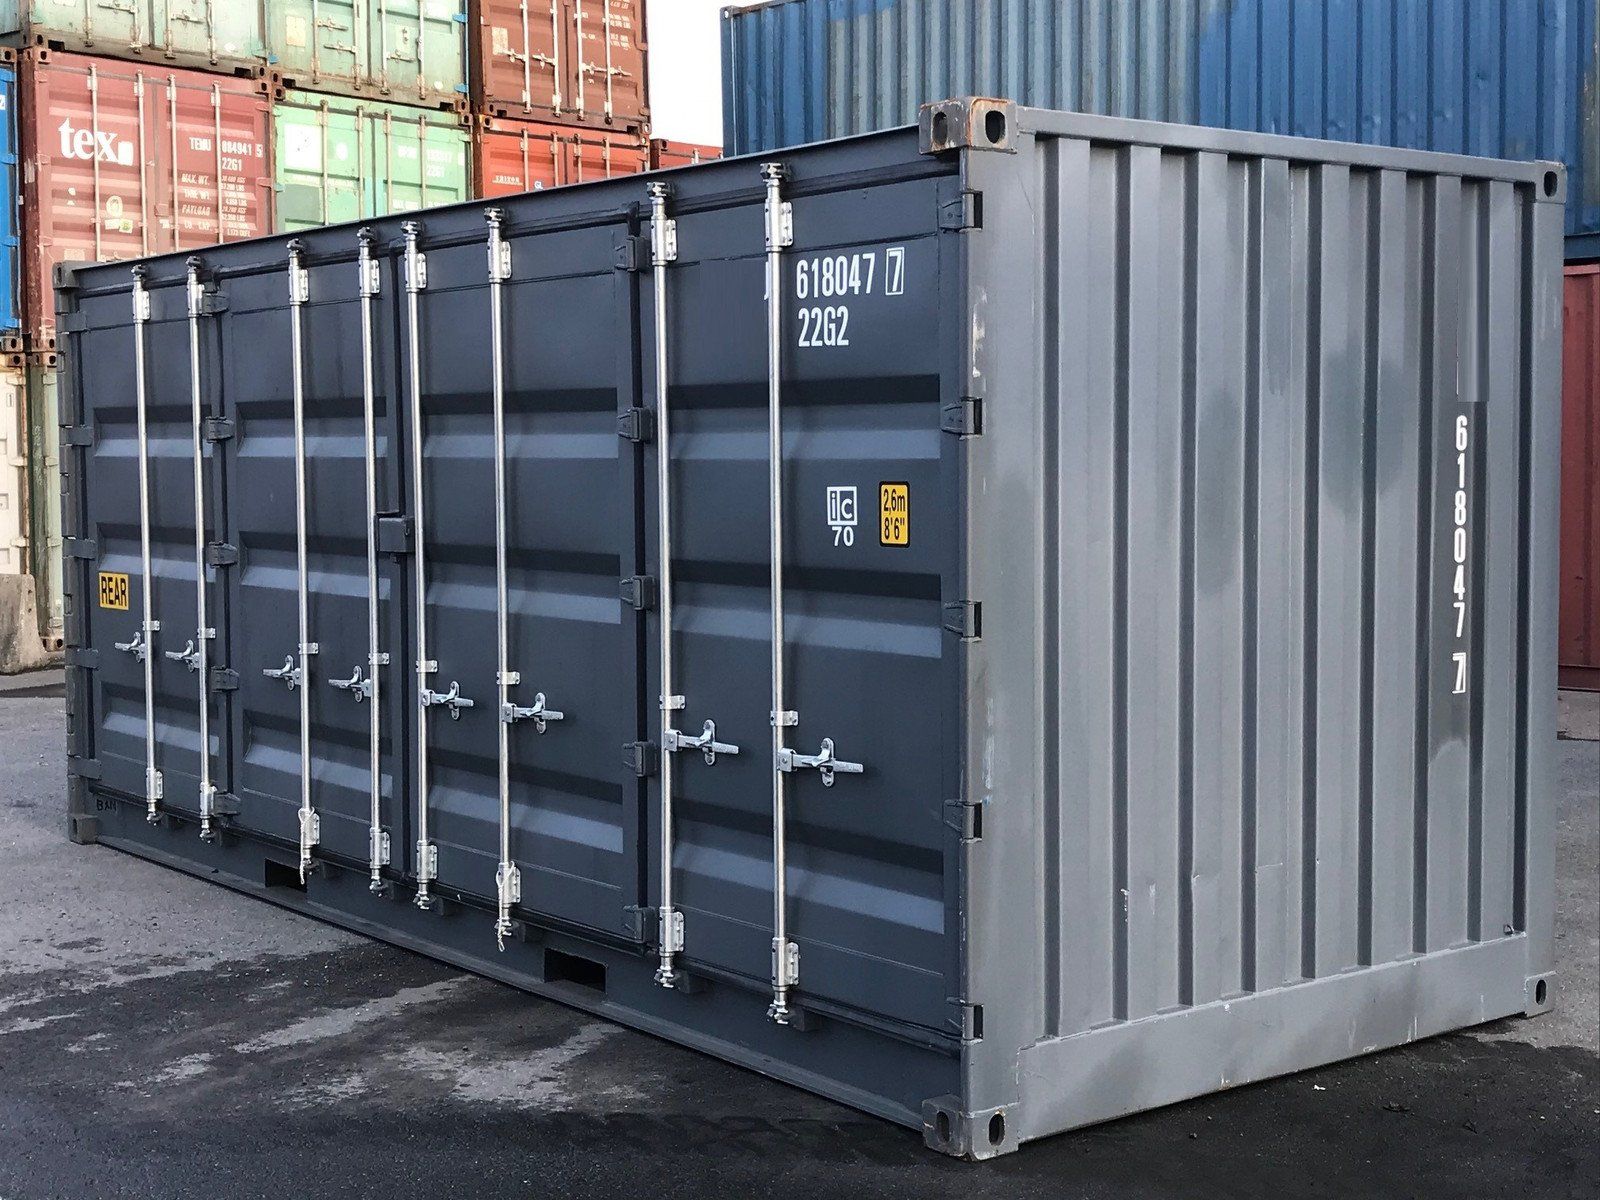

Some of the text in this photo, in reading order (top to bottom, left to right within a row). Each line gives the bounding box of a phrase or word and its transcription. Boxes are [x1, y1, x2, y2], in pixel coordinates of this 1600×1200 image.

[189, 137, 212, 151] TEMU
[796, 252, 876, 299] 618047
[888, 249, 903, 293] 7
[798, 305, 849, 347] 22G2
[883, 488, 906, 515] 2,6m
[831, 526, 854, 547] 70
[1453, 415, 1468, 638] 618047
[101, 576, 127, 607] REAR
